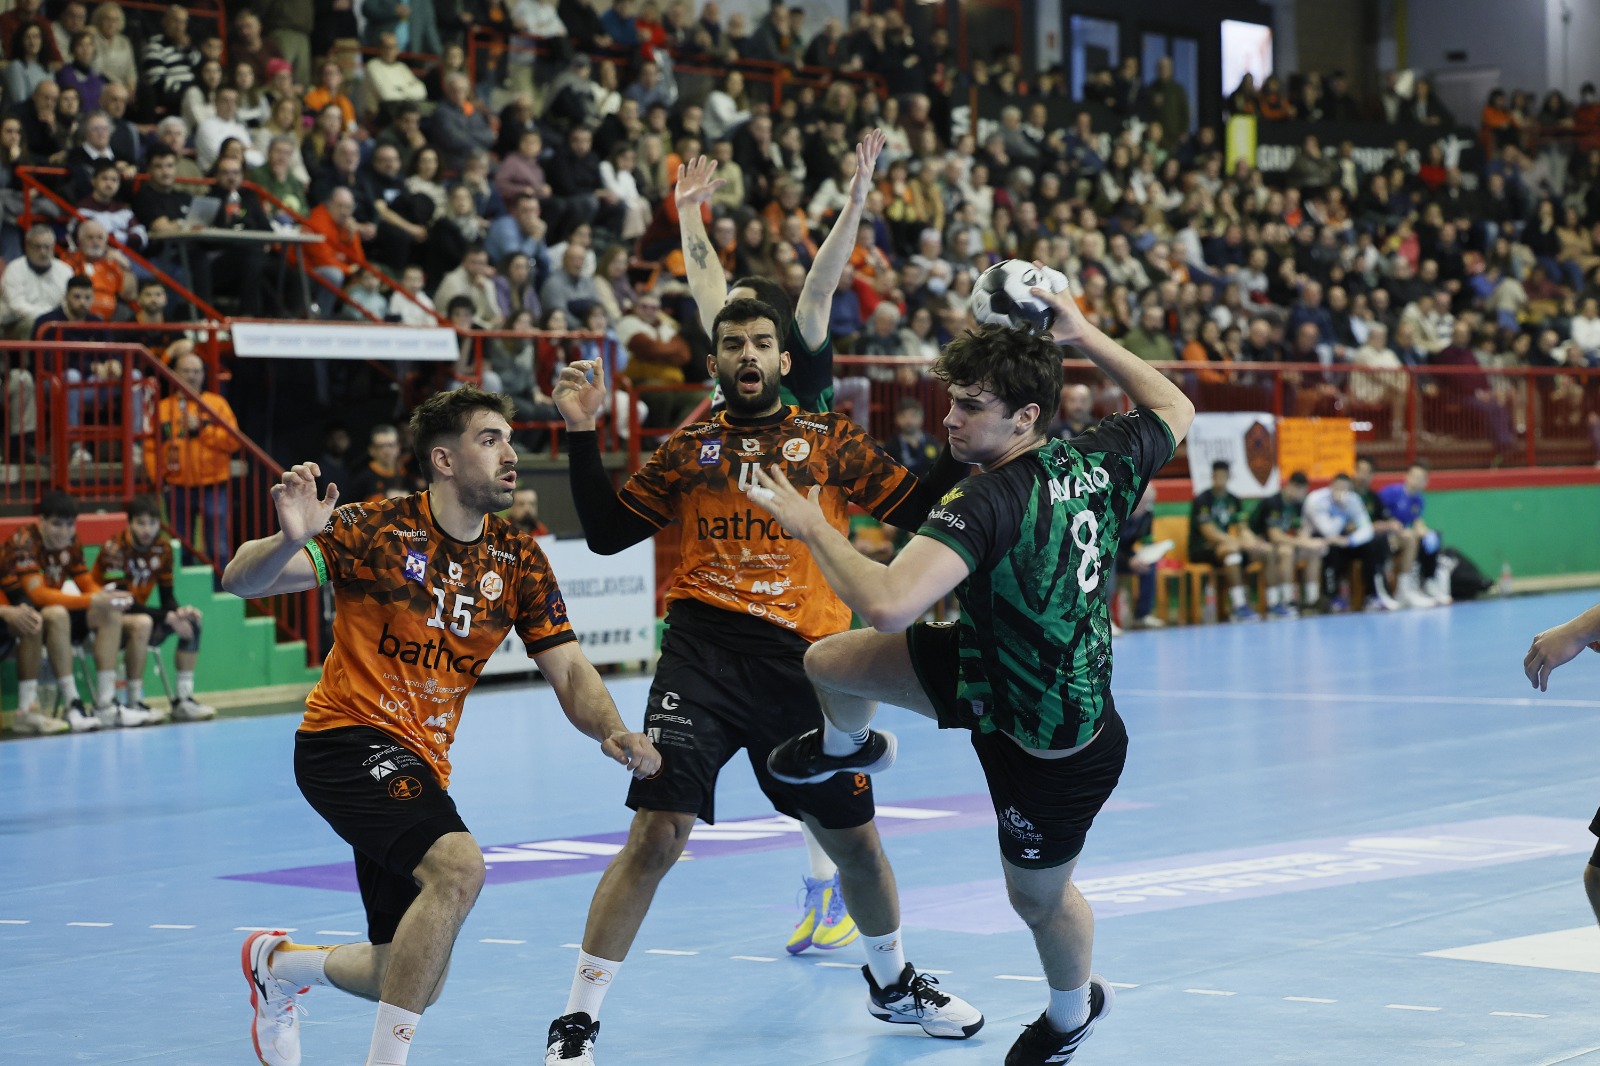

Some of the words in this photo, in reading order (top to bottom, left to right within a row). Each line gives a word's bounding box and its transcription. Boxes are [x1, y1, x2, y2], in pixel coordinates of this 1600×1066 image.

[1070, 510, 1101, 593] 8
[426, 586, 474, 638] 15
[649, 713, 694, 727] COPSESA
